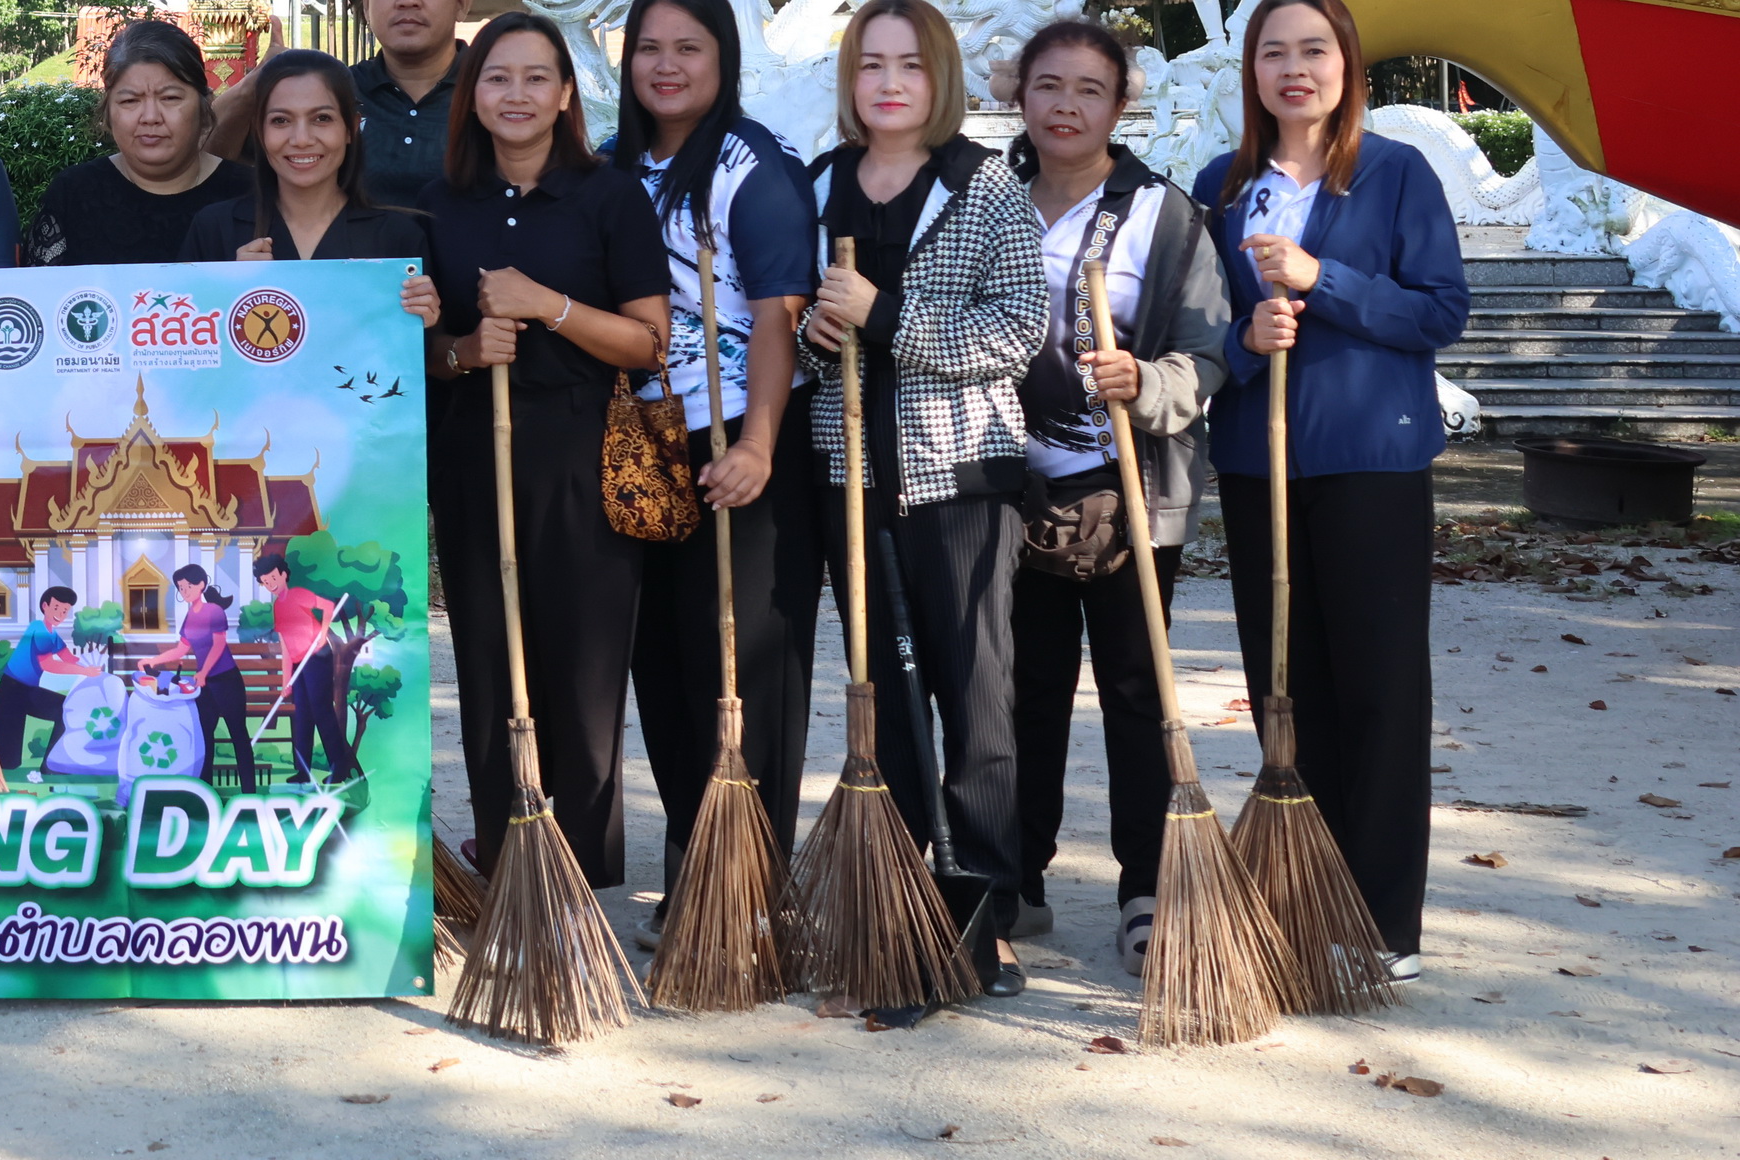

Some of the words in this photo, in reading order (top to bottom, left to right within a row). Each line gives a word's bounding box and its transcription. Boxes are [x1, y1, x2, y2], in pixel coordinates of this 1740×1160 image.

[237, 295, 297, 319] NATUREGIFT
[61, 327, 77, 347] MINISTRY
[77, 342, 85, 350] OF
[85, 341, 102, 350] PUBLIC
[102, 326, 115, 343] HEALTH
[131, 311, 221, 347] สสส
[56, 352, 120, 366] กรมอนามัย
[130, 788, 330, 876] DAY
